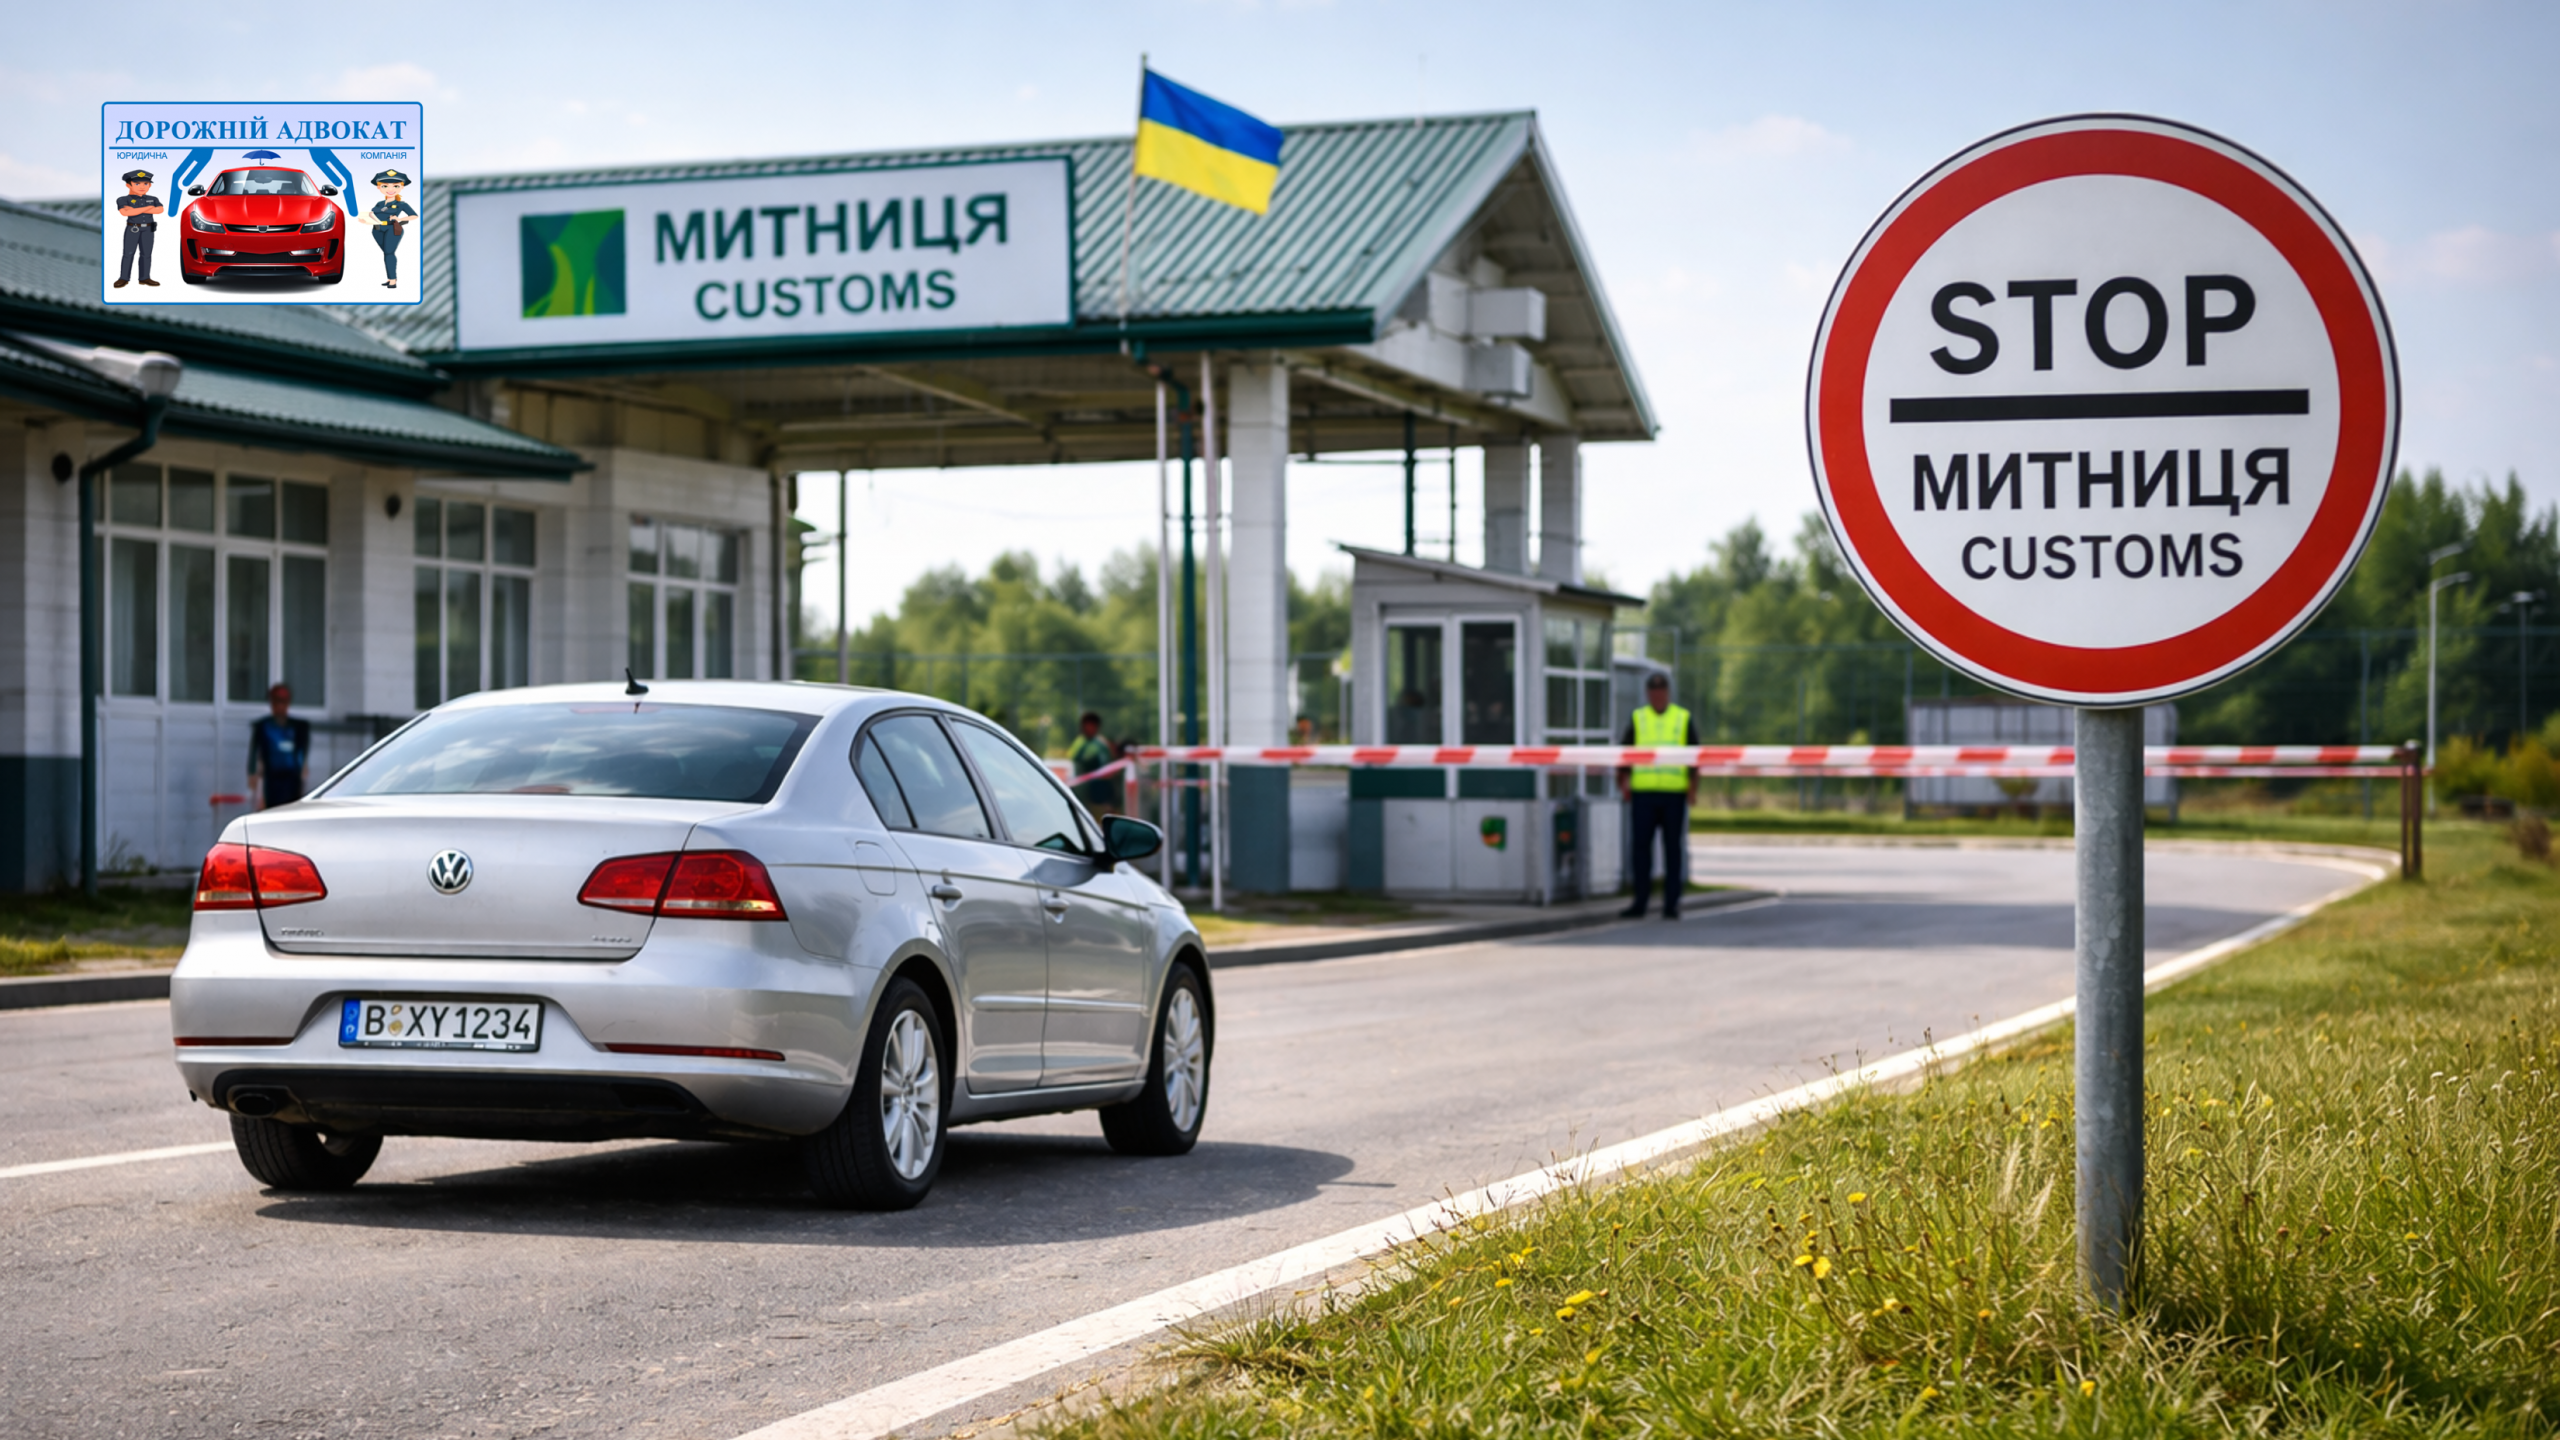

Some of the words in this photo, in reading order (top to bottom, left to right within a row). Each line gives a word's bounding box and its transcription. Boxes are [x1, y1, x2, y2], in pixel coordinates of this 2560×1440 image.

[654, 193, 1008, 264] МИТНИЦЯ
[694, 269, 957, 321] CUSTOMS
[1929, 274, 2256, 375] STOP
[1912, 447, 2290, 516] МИТНИЦЯ
[1961, 532, 2244, 581] CUSTOMS
